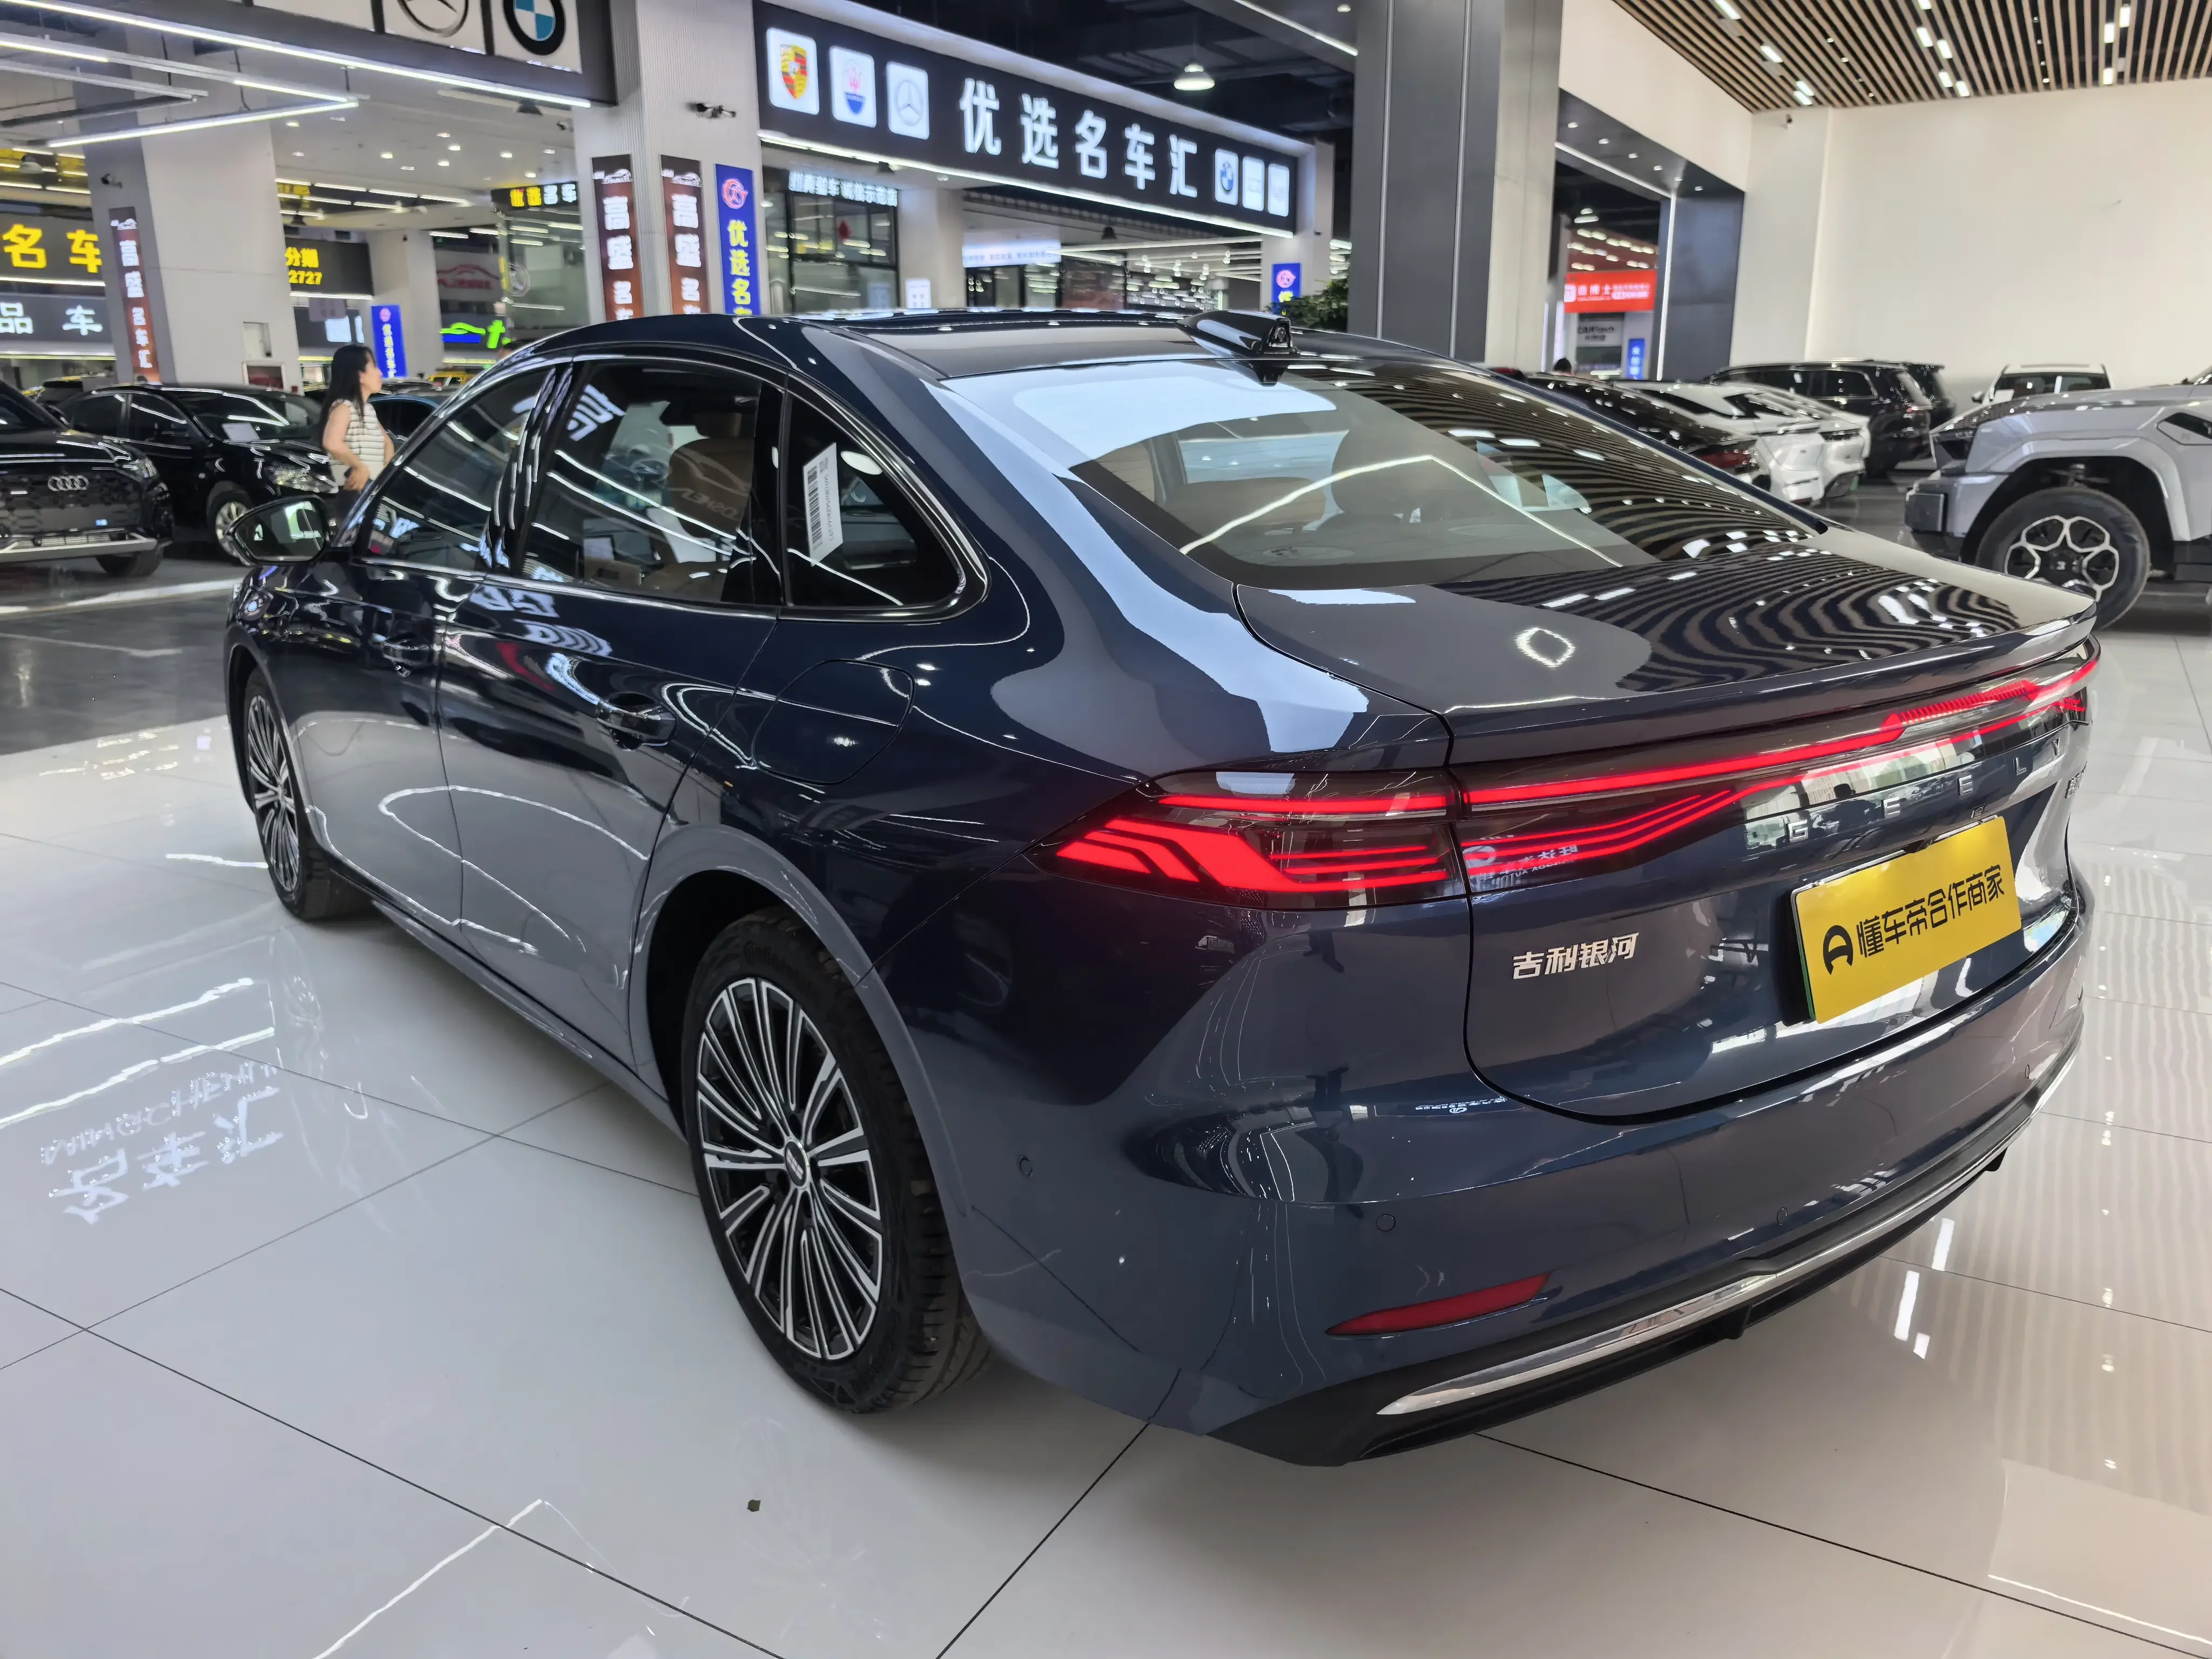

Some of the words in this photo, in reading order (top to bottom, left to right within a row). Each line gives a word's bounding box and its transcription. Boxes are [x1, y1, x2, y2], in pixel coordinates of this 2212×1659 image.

[960, 77, 1198, 198] 优选名车汇
[2, 224, 103, 273] 名车
[288, 269, 322, 285] 2727
[0, 302, 103, 336] 品车
[1788, 737, 2061, 844] GEELY
[1856, 865, 2005, 959] 懂车帝合作商家
[1513, 932, 1640, 980] 吉利银河
